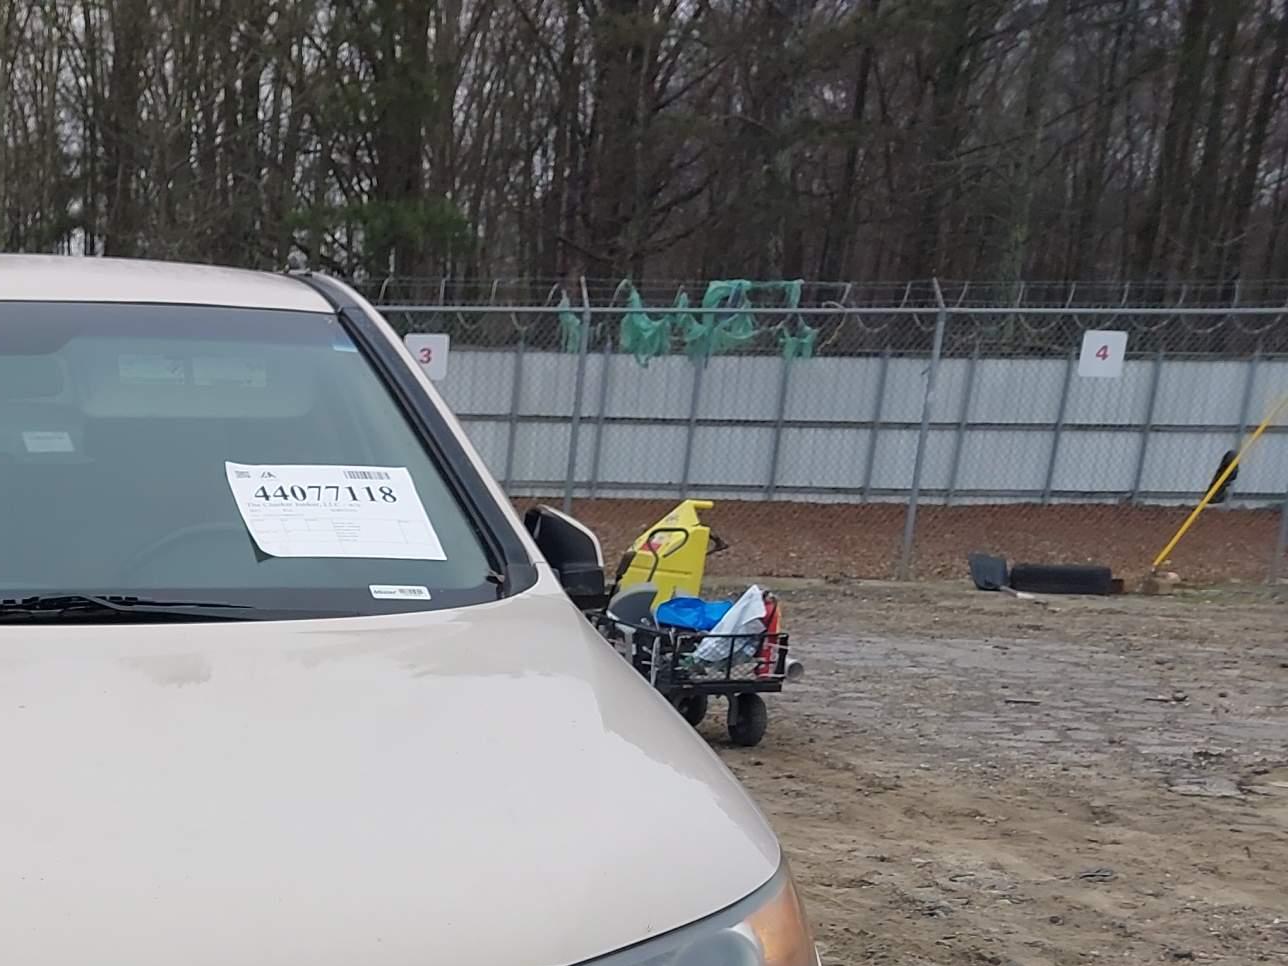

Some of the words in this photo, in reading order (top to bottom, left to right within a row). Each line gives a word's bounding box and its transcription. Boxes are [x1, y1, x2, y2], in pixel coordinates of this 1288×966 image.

[419, 347, 433, 365] 3
[1095, 344, 1109, 361] 4
[254, 484, 397, 503] 44077118
